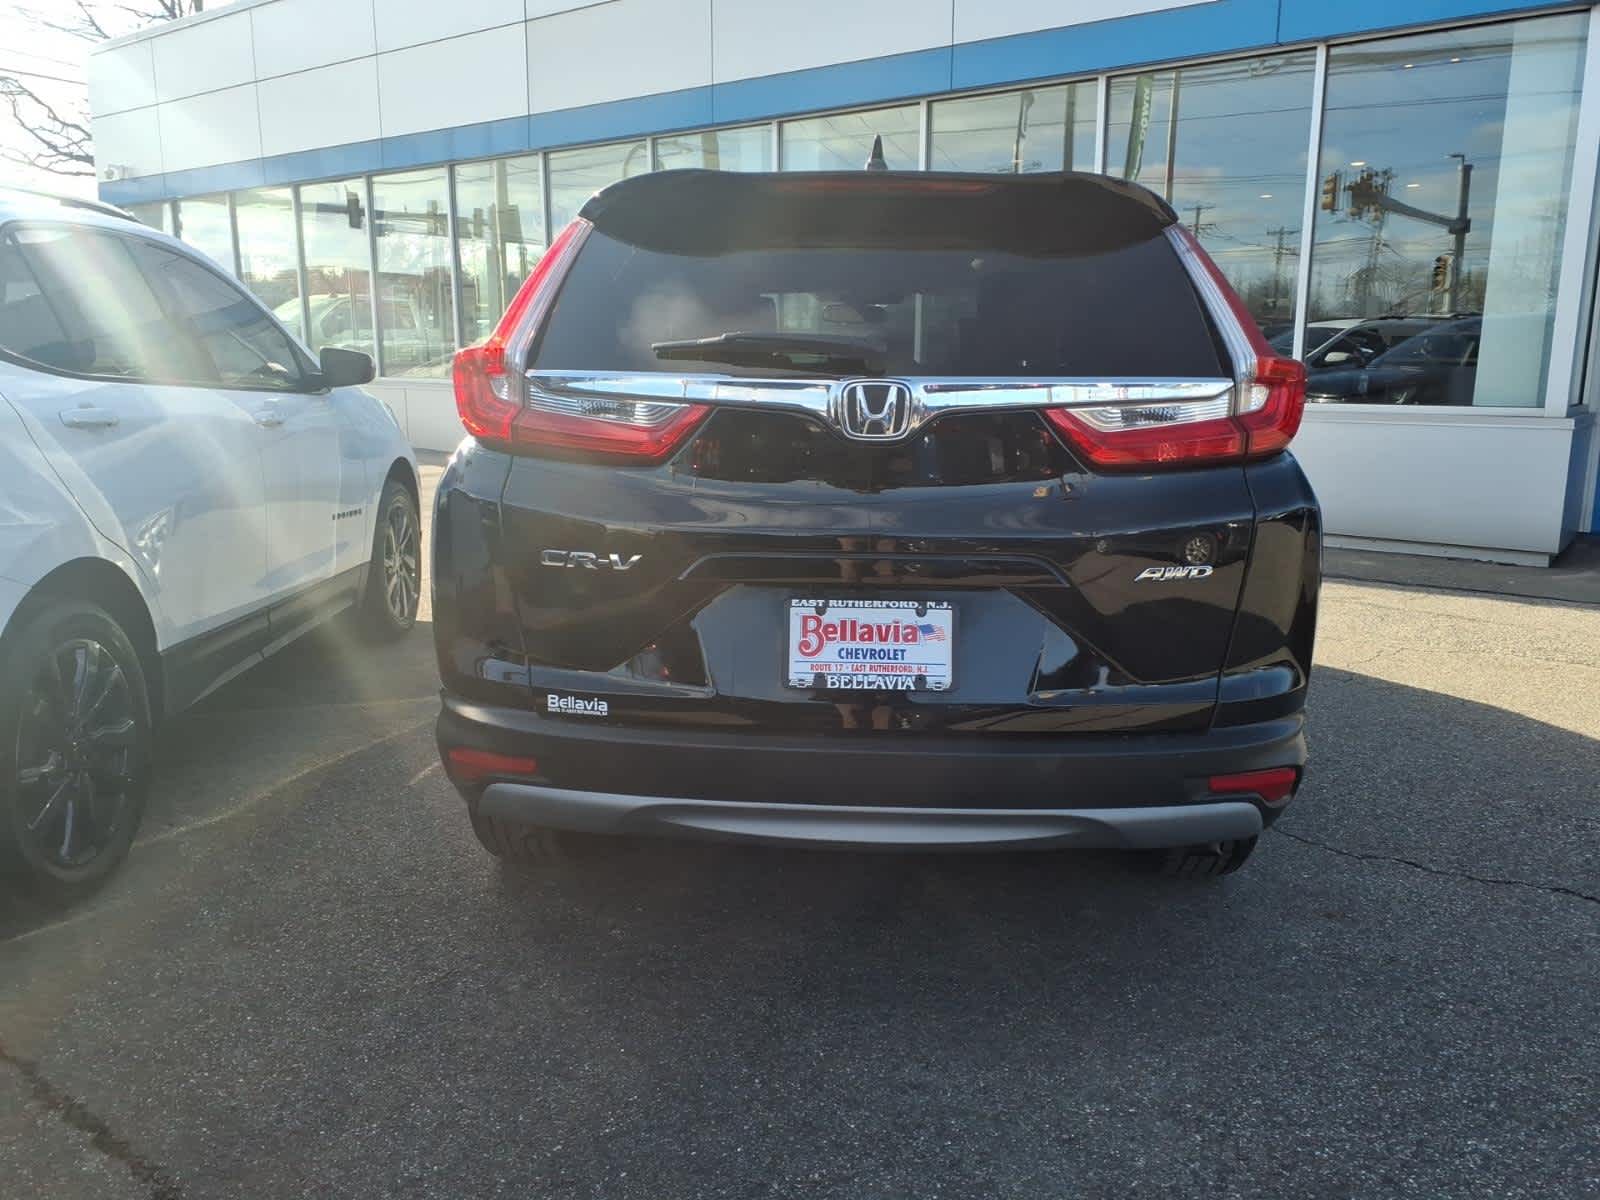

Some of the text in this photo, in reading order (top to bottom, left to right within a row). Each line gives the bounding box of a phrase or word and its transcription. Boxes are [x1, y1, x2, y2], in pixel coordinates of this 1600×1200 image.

[541, 549, 642, 570] CR-V
[1134, 565, 1214, 581] AWD
[791, 599, 825, 607] EAST
[926, 601, 952, 609] N.J.
[798, 614, 918, 657] Bellavia
[838, 647, 906, 661] CHEVROLET
[810, 663, 832, 671] ROUTE
[851, 664, 866, 672] EAST
[826, 675, 916, 690] BELLAVIA
[547, 694, 608, 711] Bellavia
